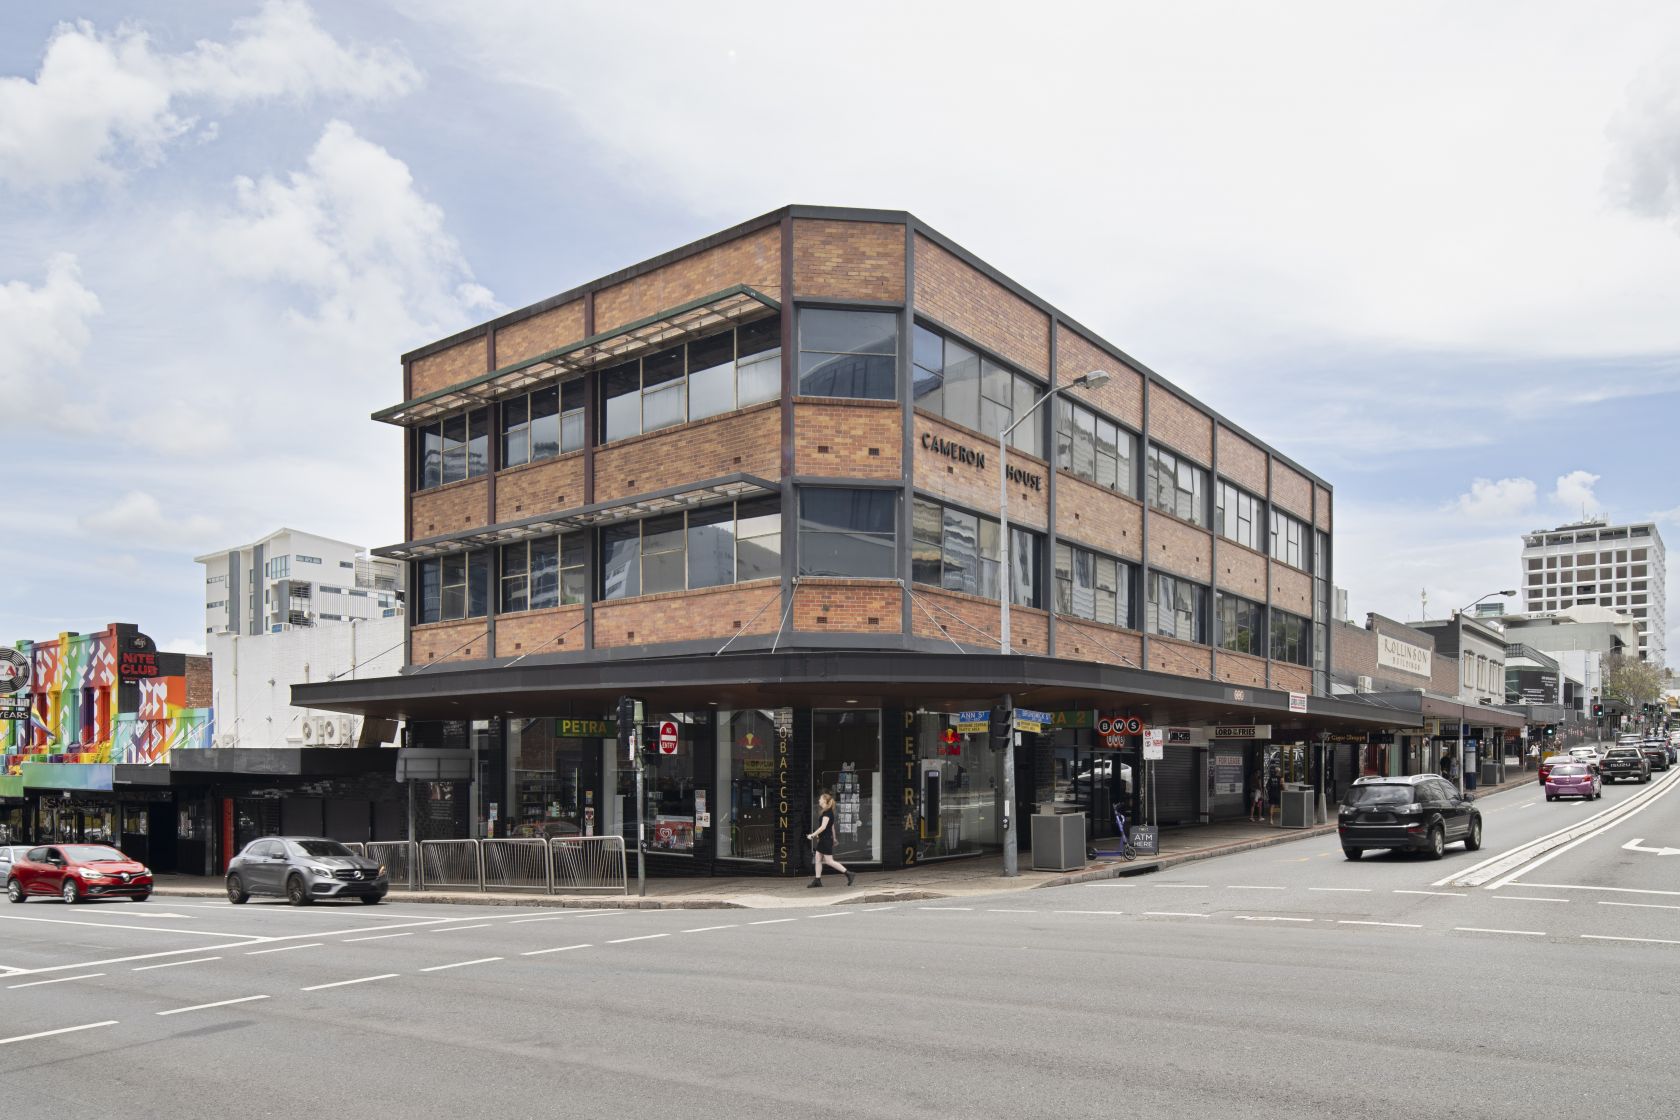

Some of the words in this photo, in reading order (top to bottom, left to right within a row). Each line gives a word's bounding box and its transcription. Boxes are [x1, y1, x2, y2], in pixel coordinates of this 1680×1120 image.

[921, 432, 985, 469] CAMERON
[1005, 464, 1041, 491] HOUSE
[123, 653, 154, 664] NITE
[121, 664, 158, 675] CLUB
[562, 720, 607, 732] PETRA
[904, 711, 914, 831] PETRA
[780, 712, 788, 873] TOBACCONIST
[905, 847, 914, 864] 2
